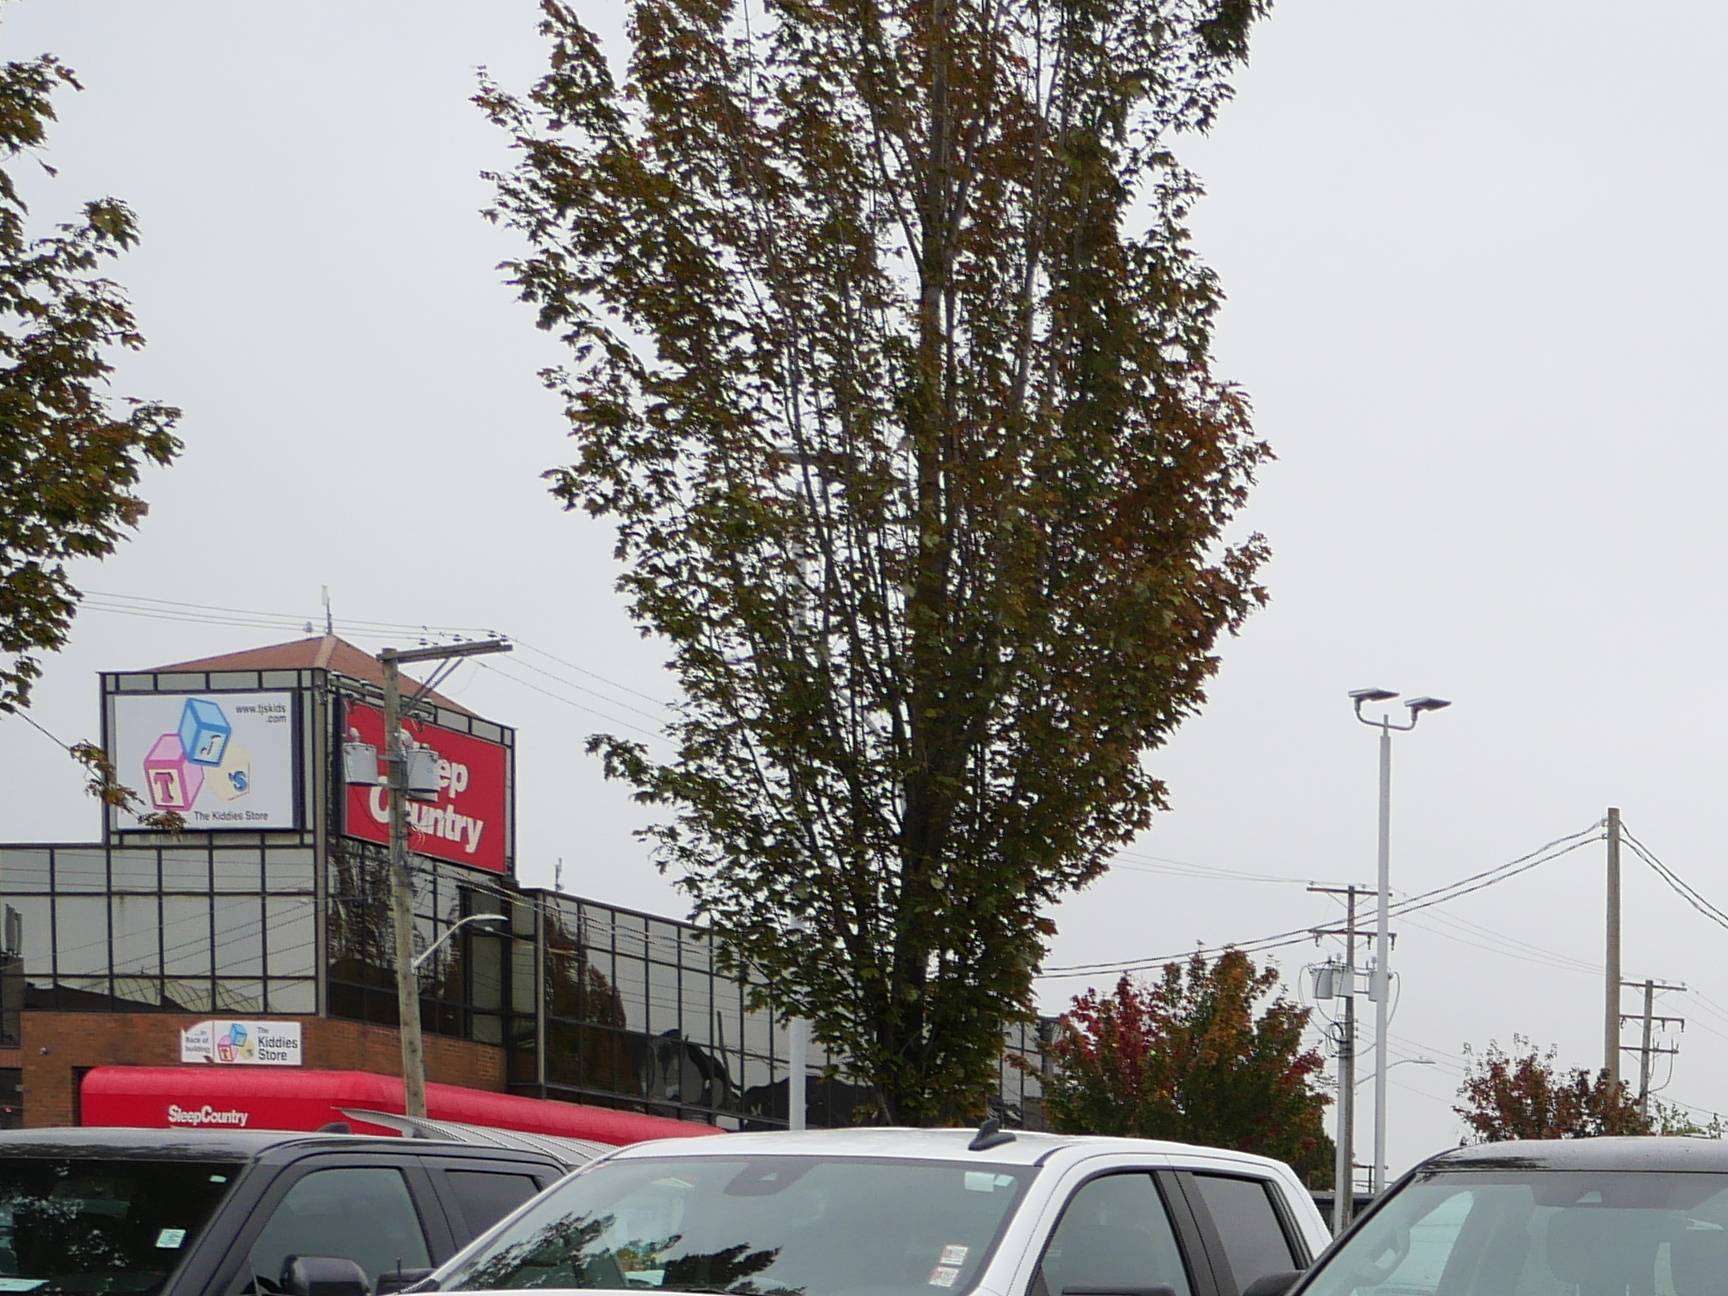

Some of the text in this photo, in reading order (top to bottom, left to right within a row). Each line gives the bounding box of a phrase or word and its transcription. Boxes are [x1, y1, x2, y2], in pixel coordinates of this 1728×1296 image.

[194, 810, 268, 821] The Kiddies Store
[257, 1026, 269, 1034] The
[257, 1036, 299, 1049] Kiddies
[258, 1049, 288, 1061] Store
